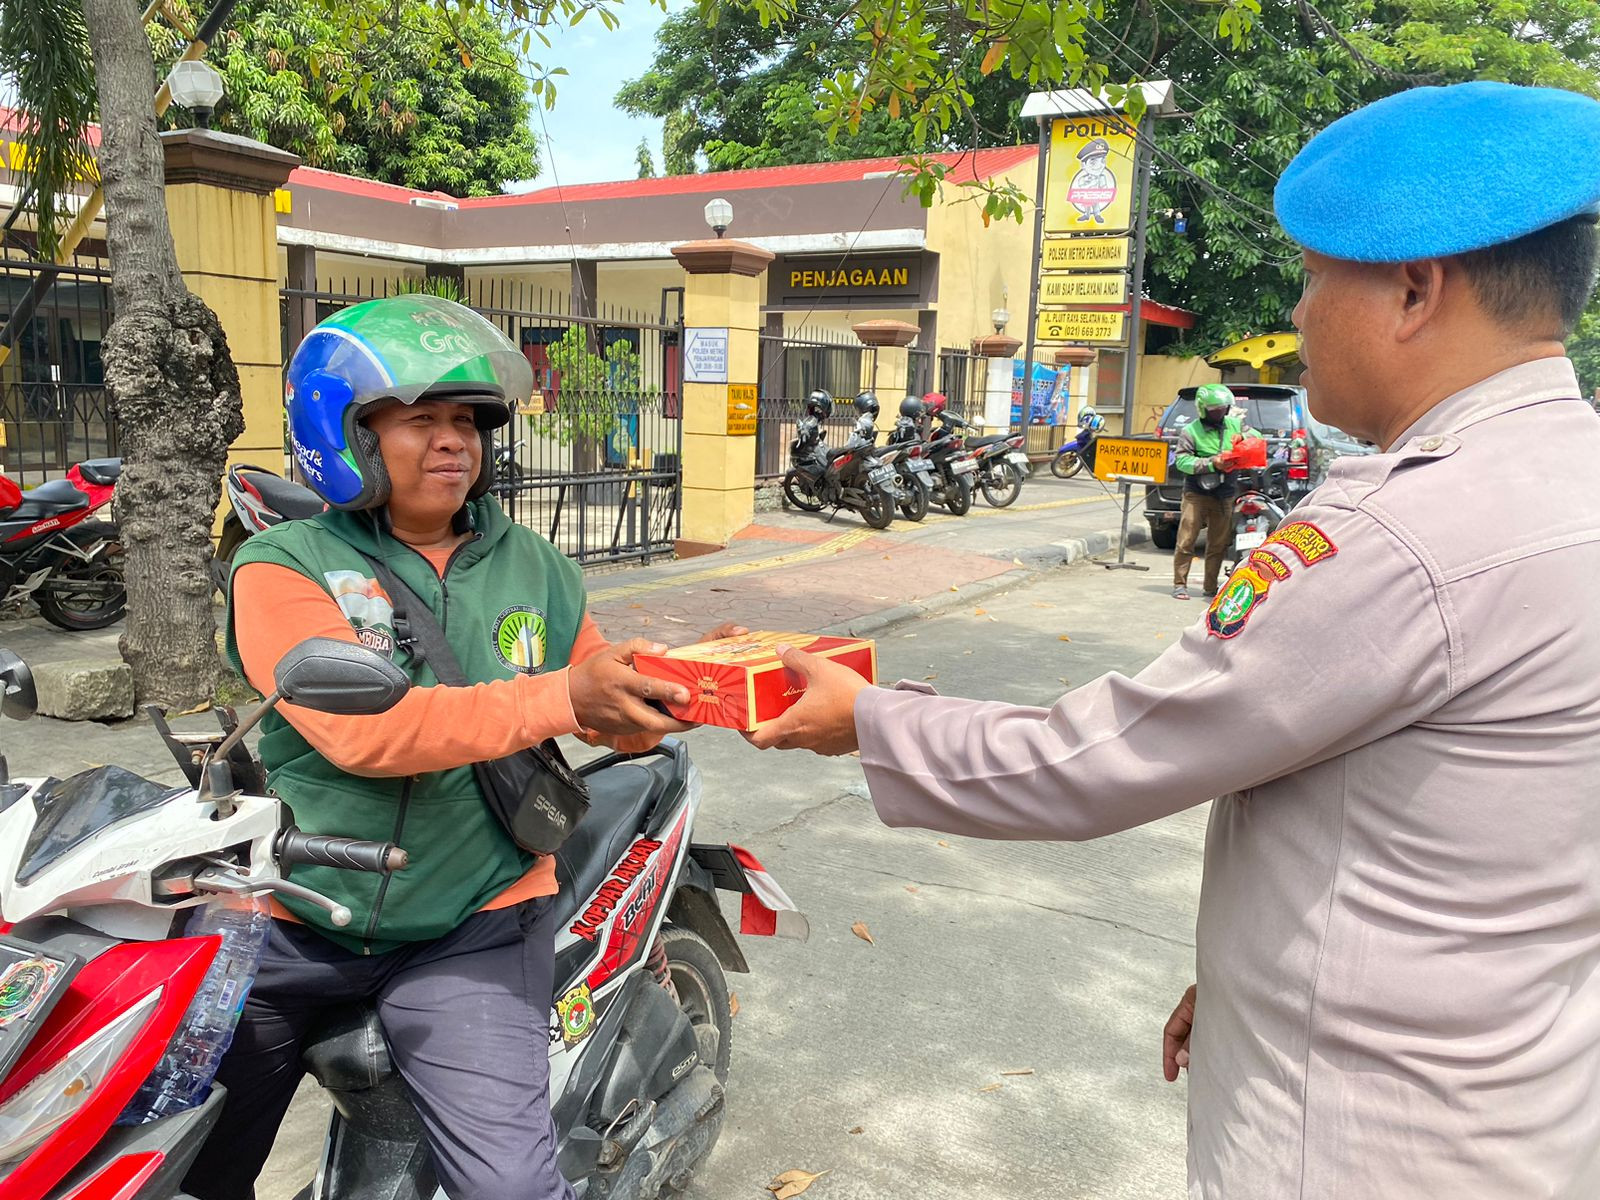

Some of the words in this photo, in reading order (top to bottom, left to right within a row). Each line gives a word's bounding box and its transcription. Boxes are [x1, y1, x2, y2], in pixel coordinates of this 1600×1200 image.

[1048, 247, 1068, 260] POLSEK
[1069, 246, 1086, 260] METRO
[1087, 245, 1122, 260] PENJARINGAN
[790, 268, 908, 287] PENJAGAAN
[1047, 283, 1061, 296] KAMI
[1062, 283, 1075, 296] SIAP
[1076, 282, 1103, 296] MELAYANI
[1104, 282, 1119, 295] ANDA
[1053, 313, 1066, 323] PLUIT
[1067, 313, 1079, 323] RAYA
[1080, 313, 1101, 324] SELATAN
[1064, 326, 1080, 337] (021)
[1081, 327, 1094, 337] 669
[1095, 327, 1112, 337] 3773
[1100, 445, 1130, 456] PARKIR
[1132, 446, 1161, 459] MOTOR
[1114, 460, 1149, 475] TAMU
[1300, 524, 1329, 554] METRO
[533, 794, 568, 830] SPEAR
[569, 878, 631, 942] KOPDAR
